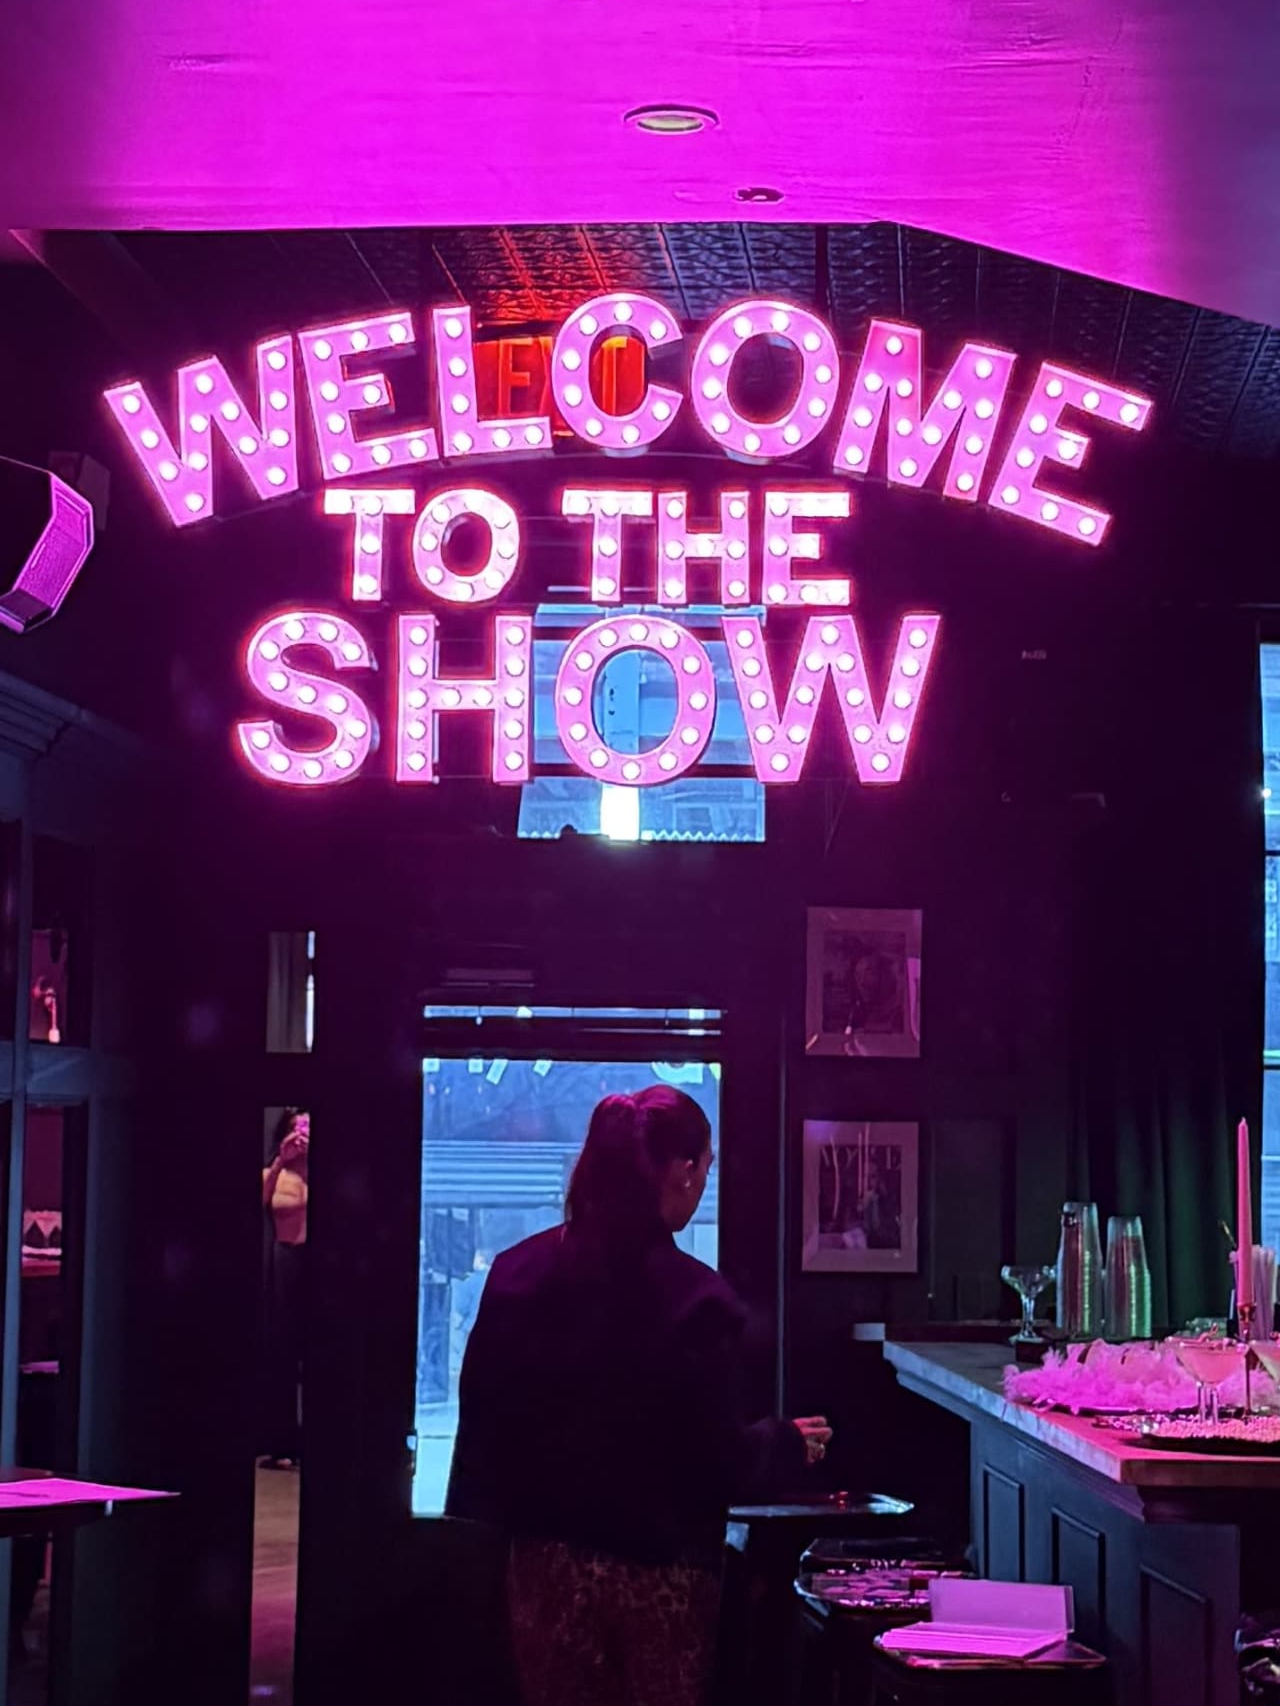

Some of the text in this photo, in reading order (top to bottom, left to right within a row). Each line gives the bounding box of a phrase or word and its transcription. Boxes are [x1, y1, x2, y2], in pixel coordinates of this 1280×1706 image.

[102, 292, 1154, 547] WELCOME
[497, 336, 628, 420] ET
[323, 488, 852, 607] TO THE
[236, 611, 941, 785] SHOW
